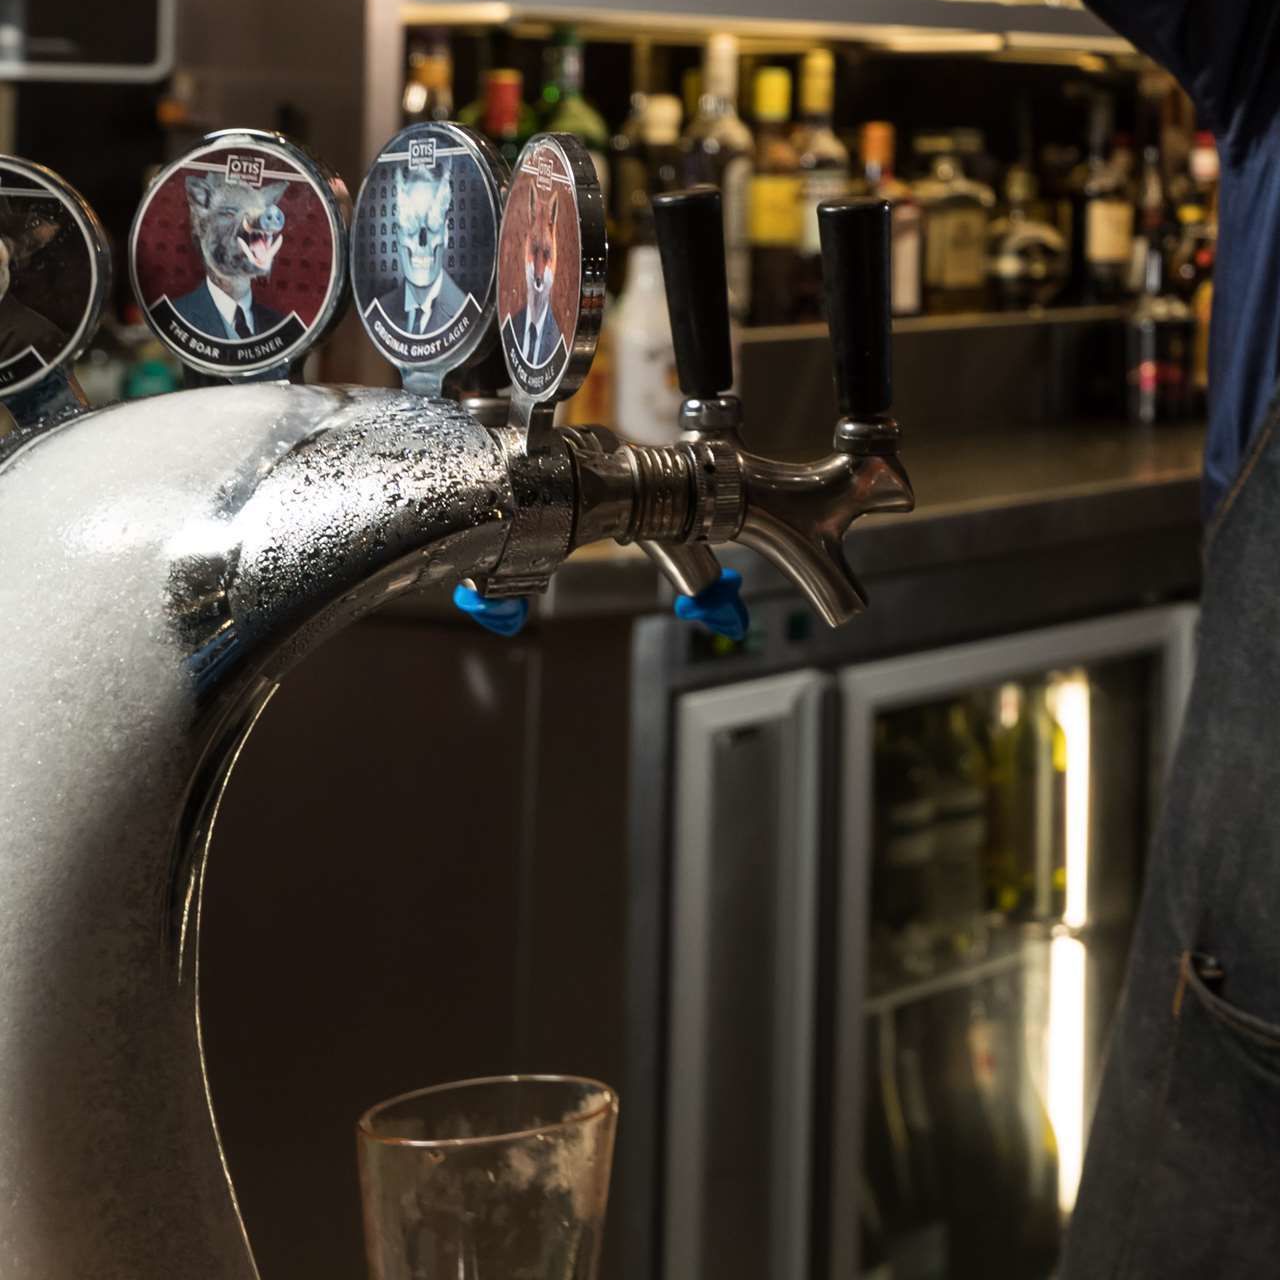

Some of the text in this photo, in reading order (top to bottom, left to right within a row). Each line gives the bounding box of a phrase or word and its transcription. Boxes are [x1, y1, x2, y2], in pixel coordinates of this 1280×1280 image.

[412, 143, 433, 157] OTIS
[231, 160, 259, 175] OTIS
[168, 320, 284, 360] THE BOAR PILSNER
[374, 316, 470, 357] ORIGINAL GHOST LAGER
